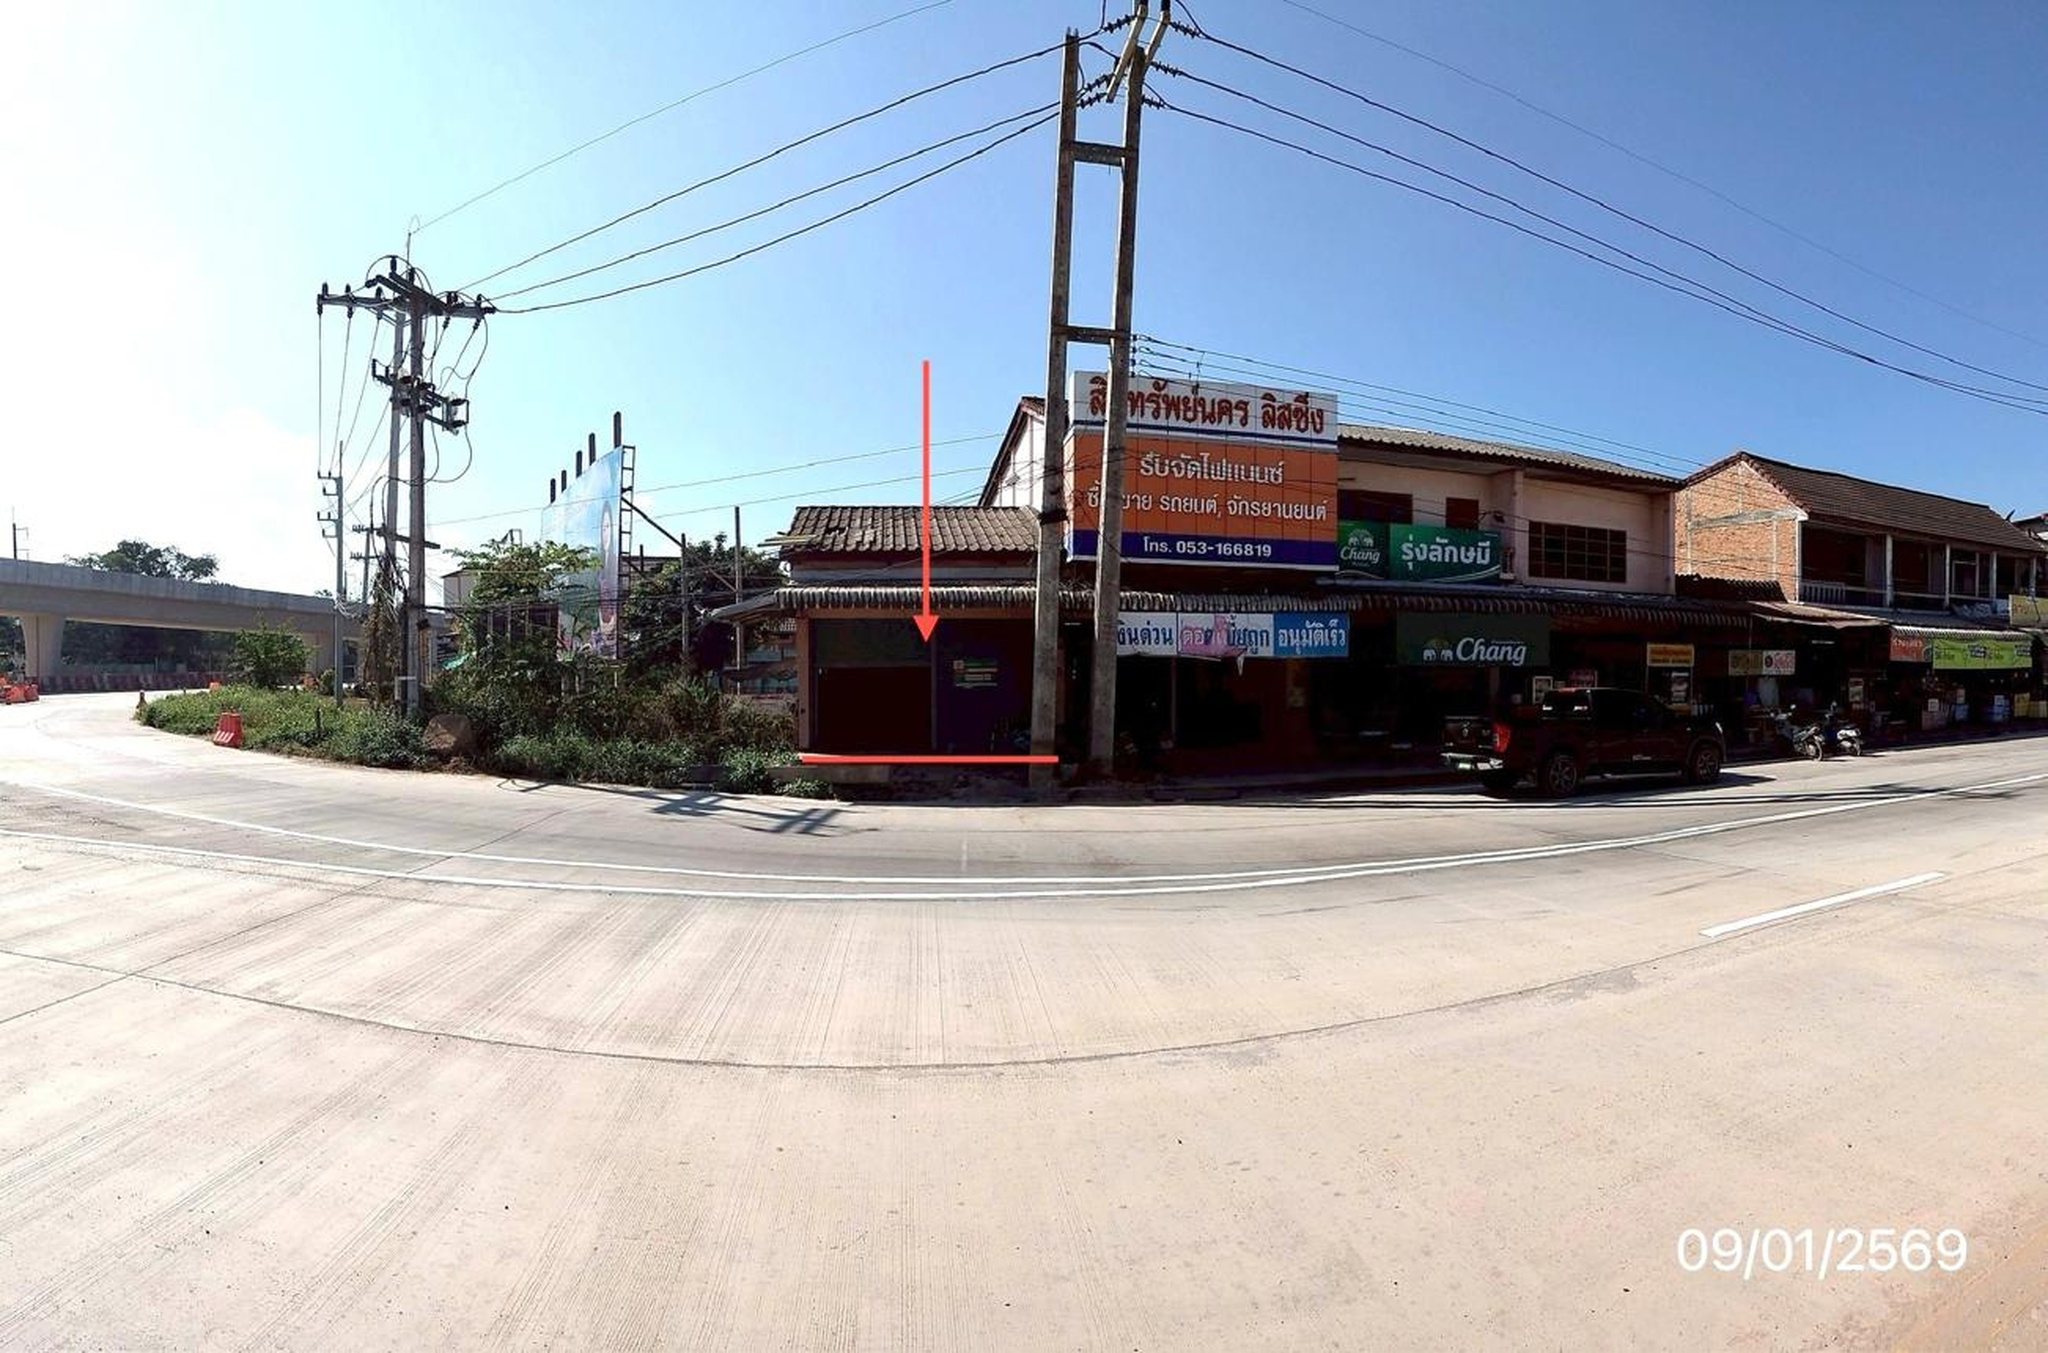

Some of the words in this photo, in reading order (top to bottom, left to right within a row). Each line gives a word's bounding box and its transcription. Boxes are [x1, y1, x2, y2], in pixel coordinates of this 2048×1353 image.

[1088, 375, 1250, 428] สิทรัพย์นคร
[1139, 451, 1286, 484] รับจัดไฟแนนซ์
[1227, 495, 1328, 522] จักรยานยนต์
[1143, 536, 1172, 554] โทร.
[1176, 540, 1272, 557] 053-166819
[1340, 546, 1381, 564] Chang
[1401, 534, 1491, 570] รุ่งลักษมี
[1117, 620, 1174, 646] งินด่วน
[1278, 620, 1346, 654] อนุมัติเร็ว
[1456, 637, 1527, 666] Chang
